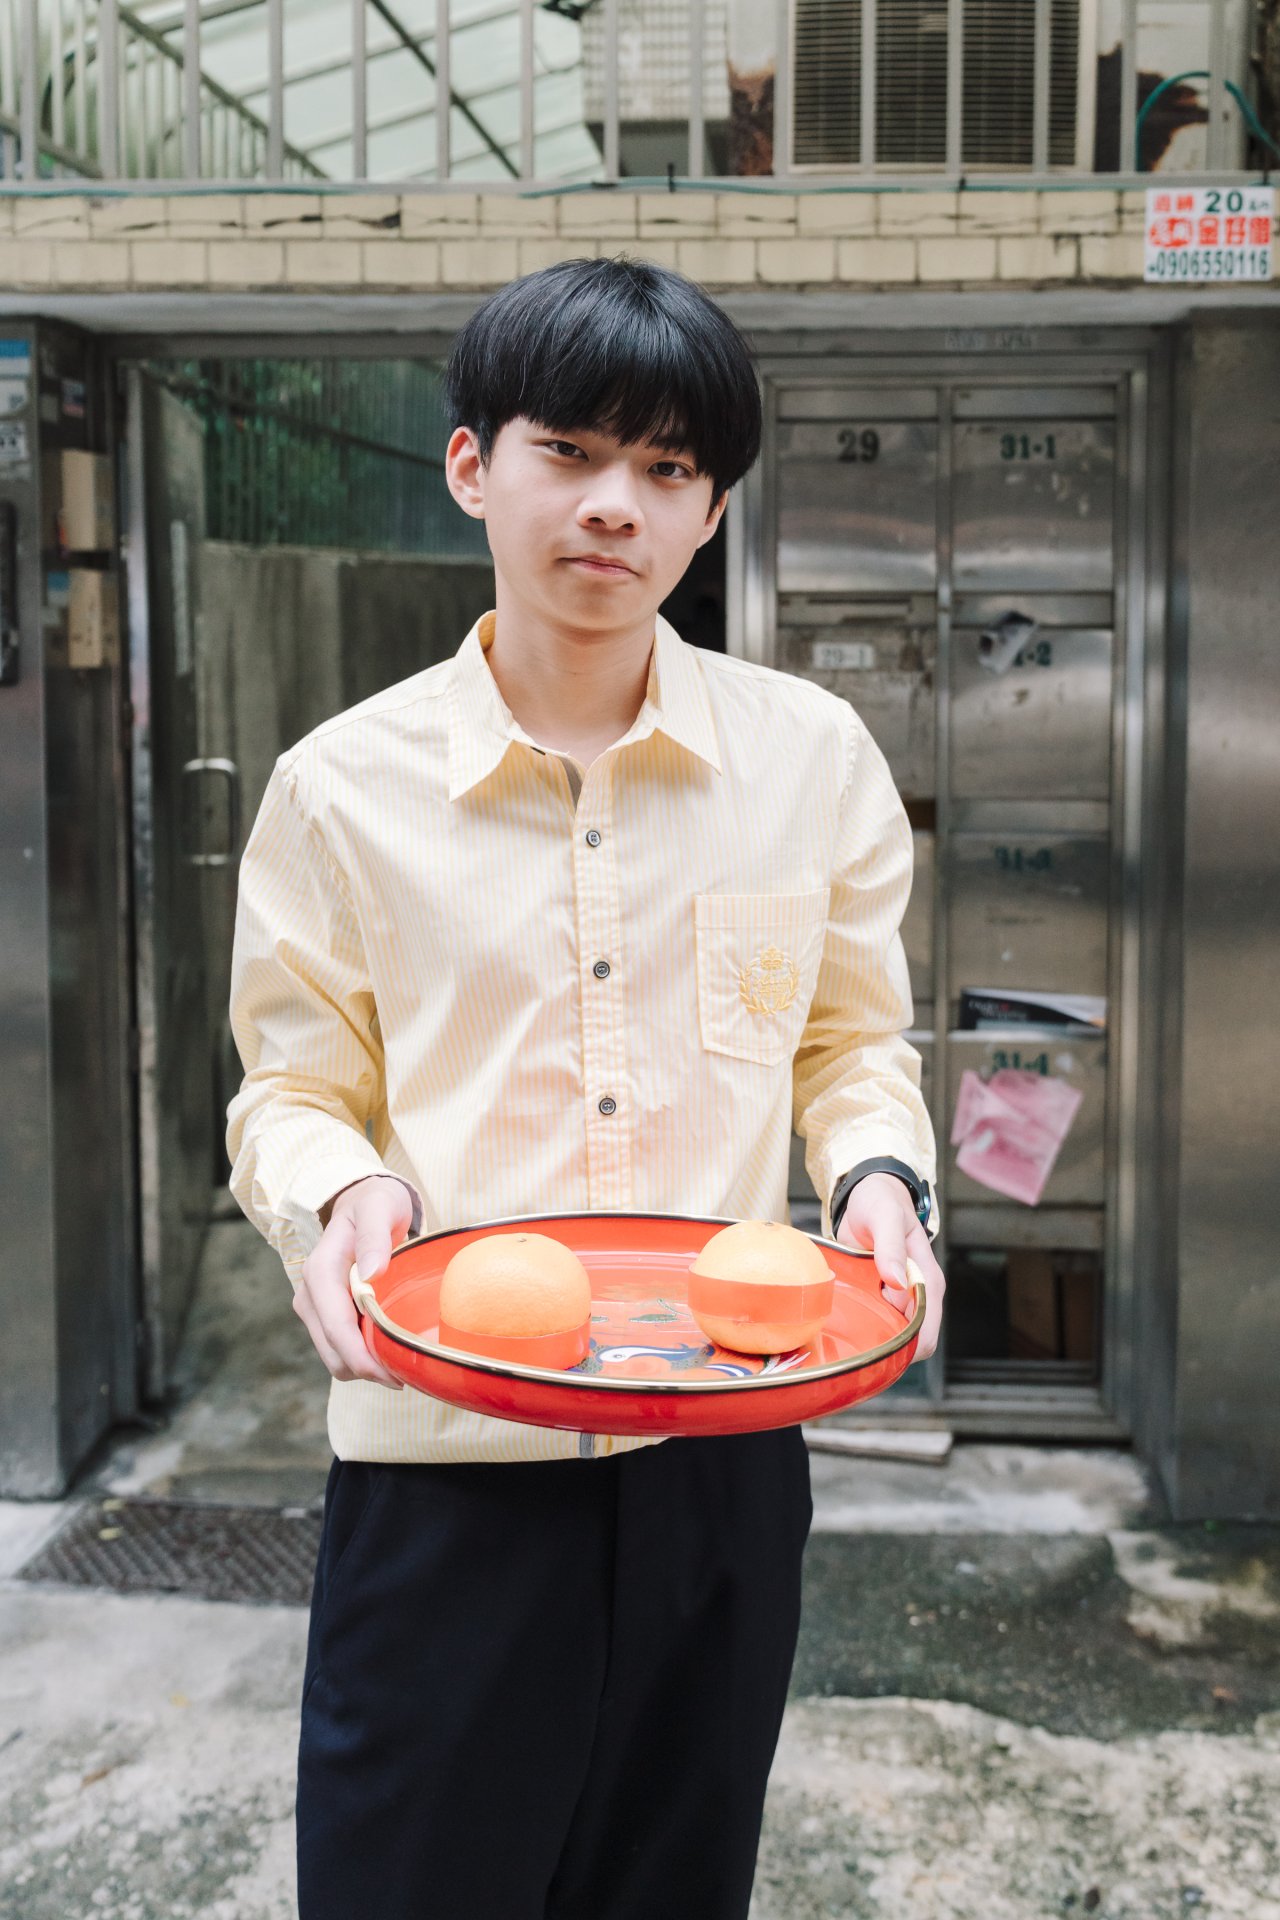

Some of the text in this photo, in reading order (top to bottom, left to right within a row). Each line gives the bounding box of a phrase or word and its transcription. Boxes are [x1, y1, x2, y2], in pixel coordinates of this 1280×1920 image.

[1205, 190, 1243, 213] 20
[1157, 251, 1268, 275] 0906550116
[837, 429, 880, 463] 29
